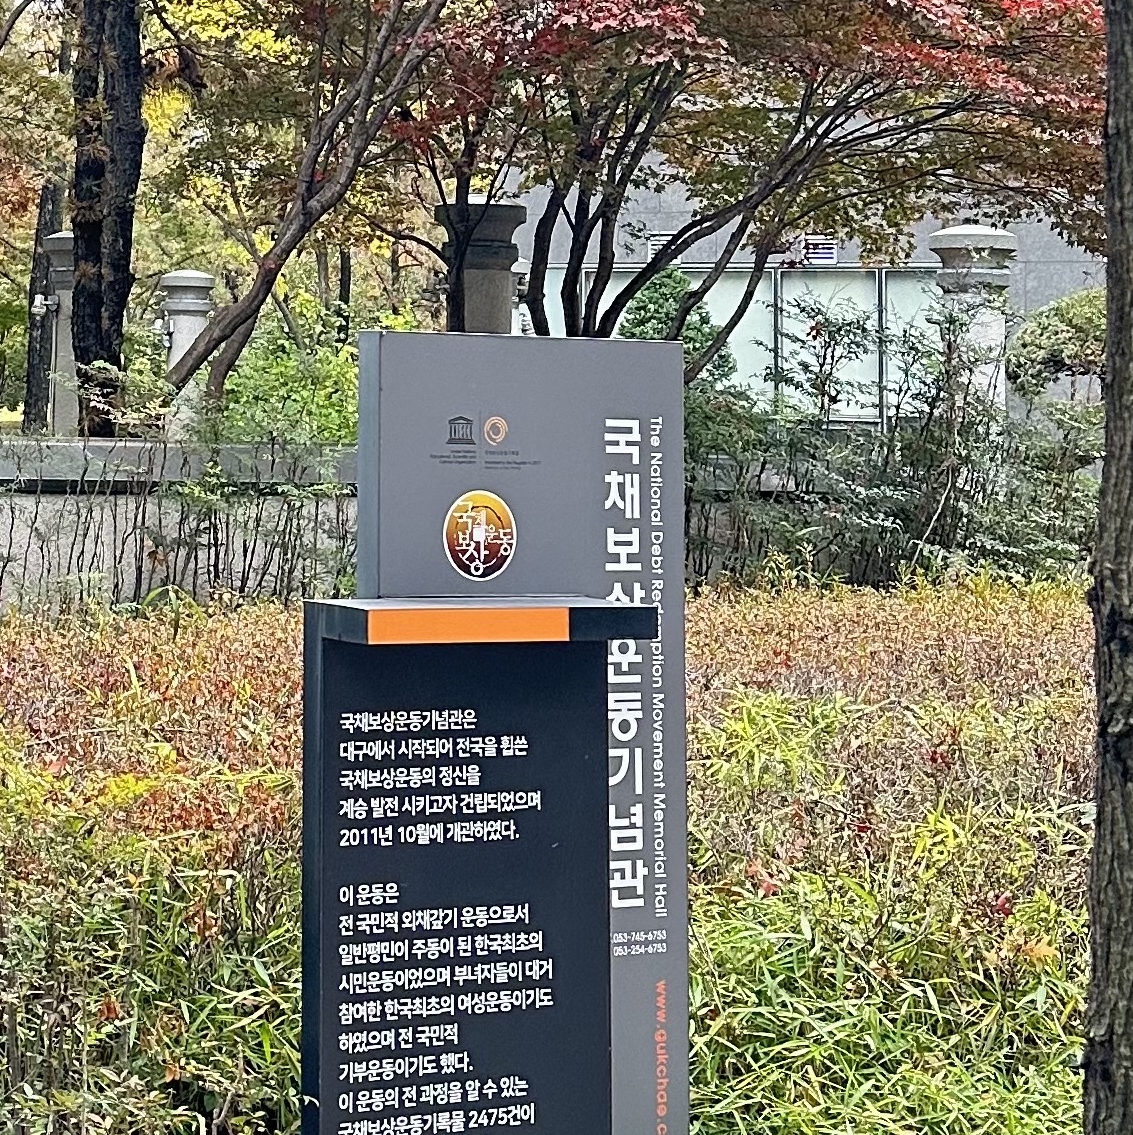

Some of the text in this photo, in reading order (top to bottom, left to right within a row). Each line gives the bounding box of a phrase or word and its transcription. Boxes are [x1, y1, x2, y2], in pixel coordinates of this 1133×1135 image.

[650, 417, 663, 448] The
[650, 452, 663, 526] National
[651, 531, 664, 575] Debt
[340, 709, 477, 733] 국채보상운동기념관은
[340, 736, 528, 761] 대구에서 시작되어 전국을 휩쓴
[652, 693, 665, 789] Movement
[340, 765, 481, 790] 국채보상운동의 정신을
[338, 791, 541, 819] 계승 발전 시키고자 건립되었으며
[340, 819, 519, 846] 2011년 10월에 개관하였다.
[653, 793, 667, 878] Memorial
[340, 883, 399, 906] 이 운동은
[654, 883, 668, 918] Hall
[339, 903, 529, 935] 전 국민적 외채갚기 운동으로서
[339, 931, 543, 965] 일반평민이 주동이 된 한국최초의
[339, 959, 552, 994] 시민운동이었으며 부녀자들이 대거
[339, 988, 553, 1024] 참여한 한국최초의 여성운동이기도
[338, 1023, 458, 1053] 하였으며 전 국민적
[339, 1051, 473, 1083] 기부운동이기도 했다.
[339, 1076, 528, 1113] 이 운동의 전 과정을 알 수 있는
[469, 1103, 534, 1128] 2475건이
